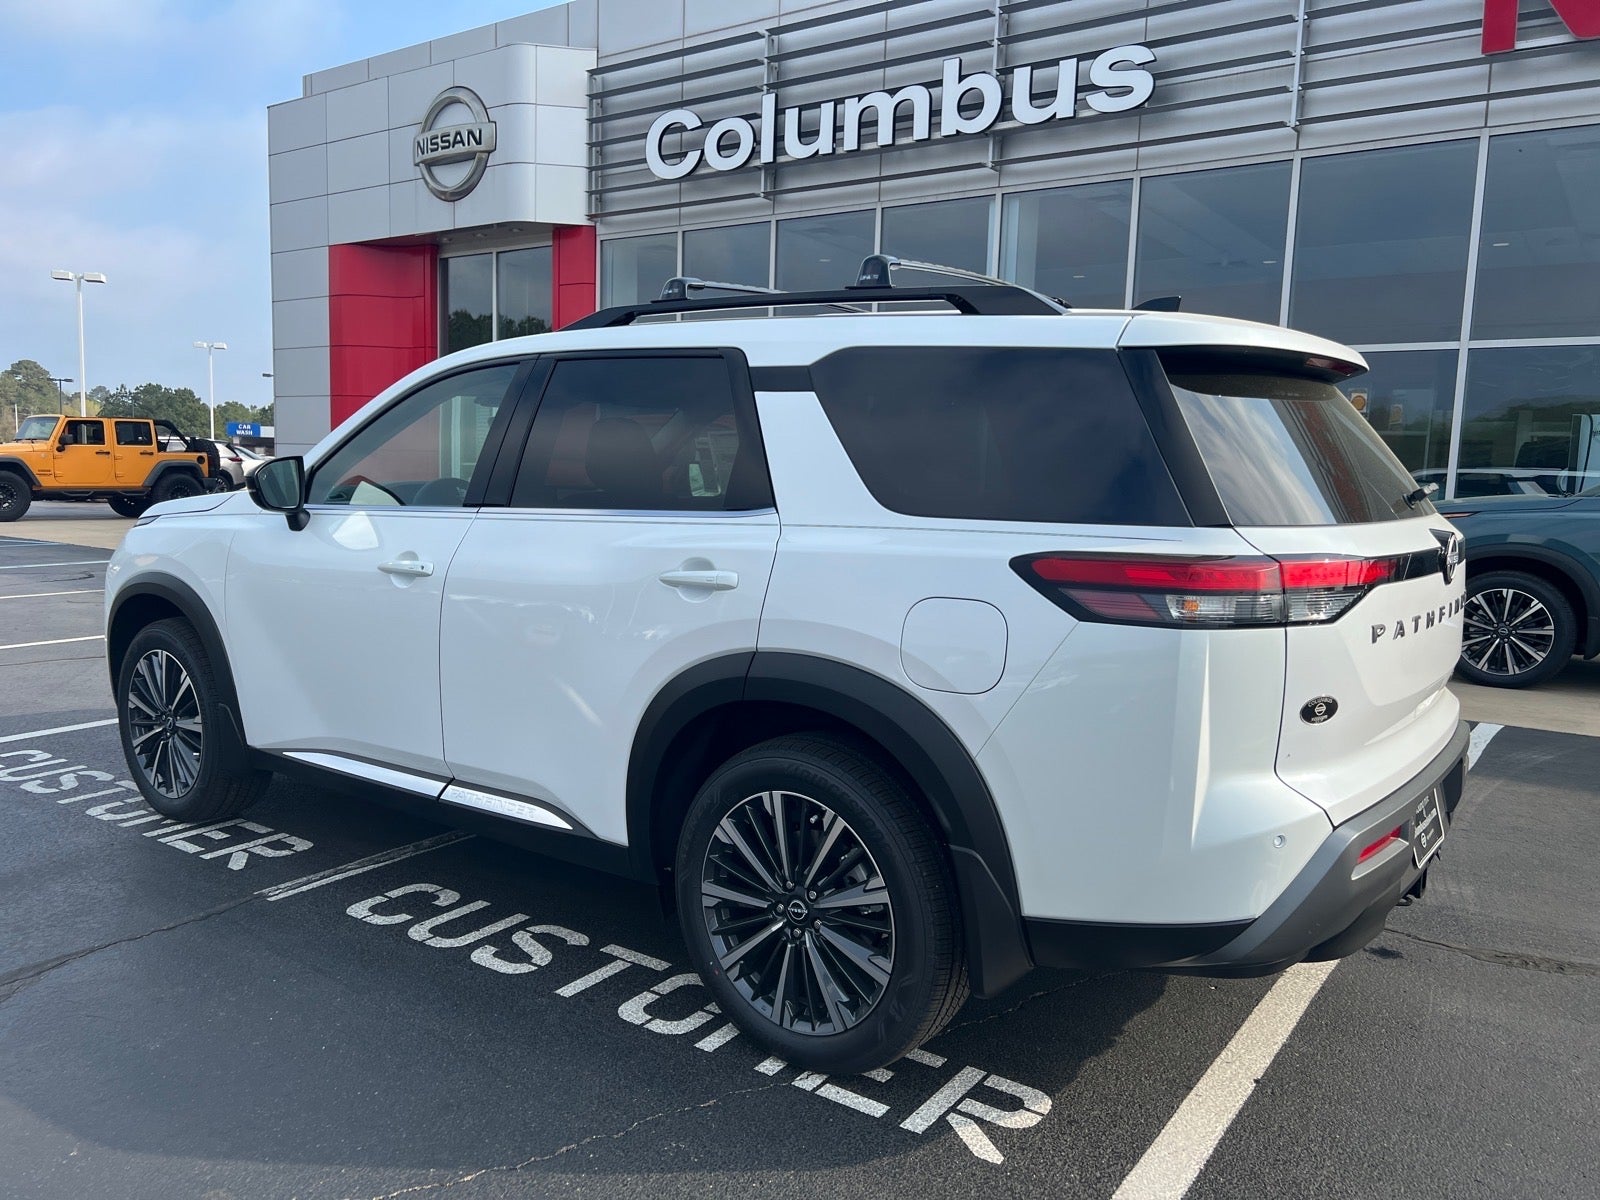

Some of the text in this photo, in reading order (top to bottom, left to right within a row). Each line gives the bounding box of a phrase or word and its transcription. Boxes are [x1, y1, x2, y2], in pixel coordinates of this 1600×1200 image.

[416, 128, 482, 158] NISSAN
[645, 44, 1157, 180] Columbus
[449, 787, 537, 819] PATHFINDER
[345, 882, 1053, 1165] CUSTOER
